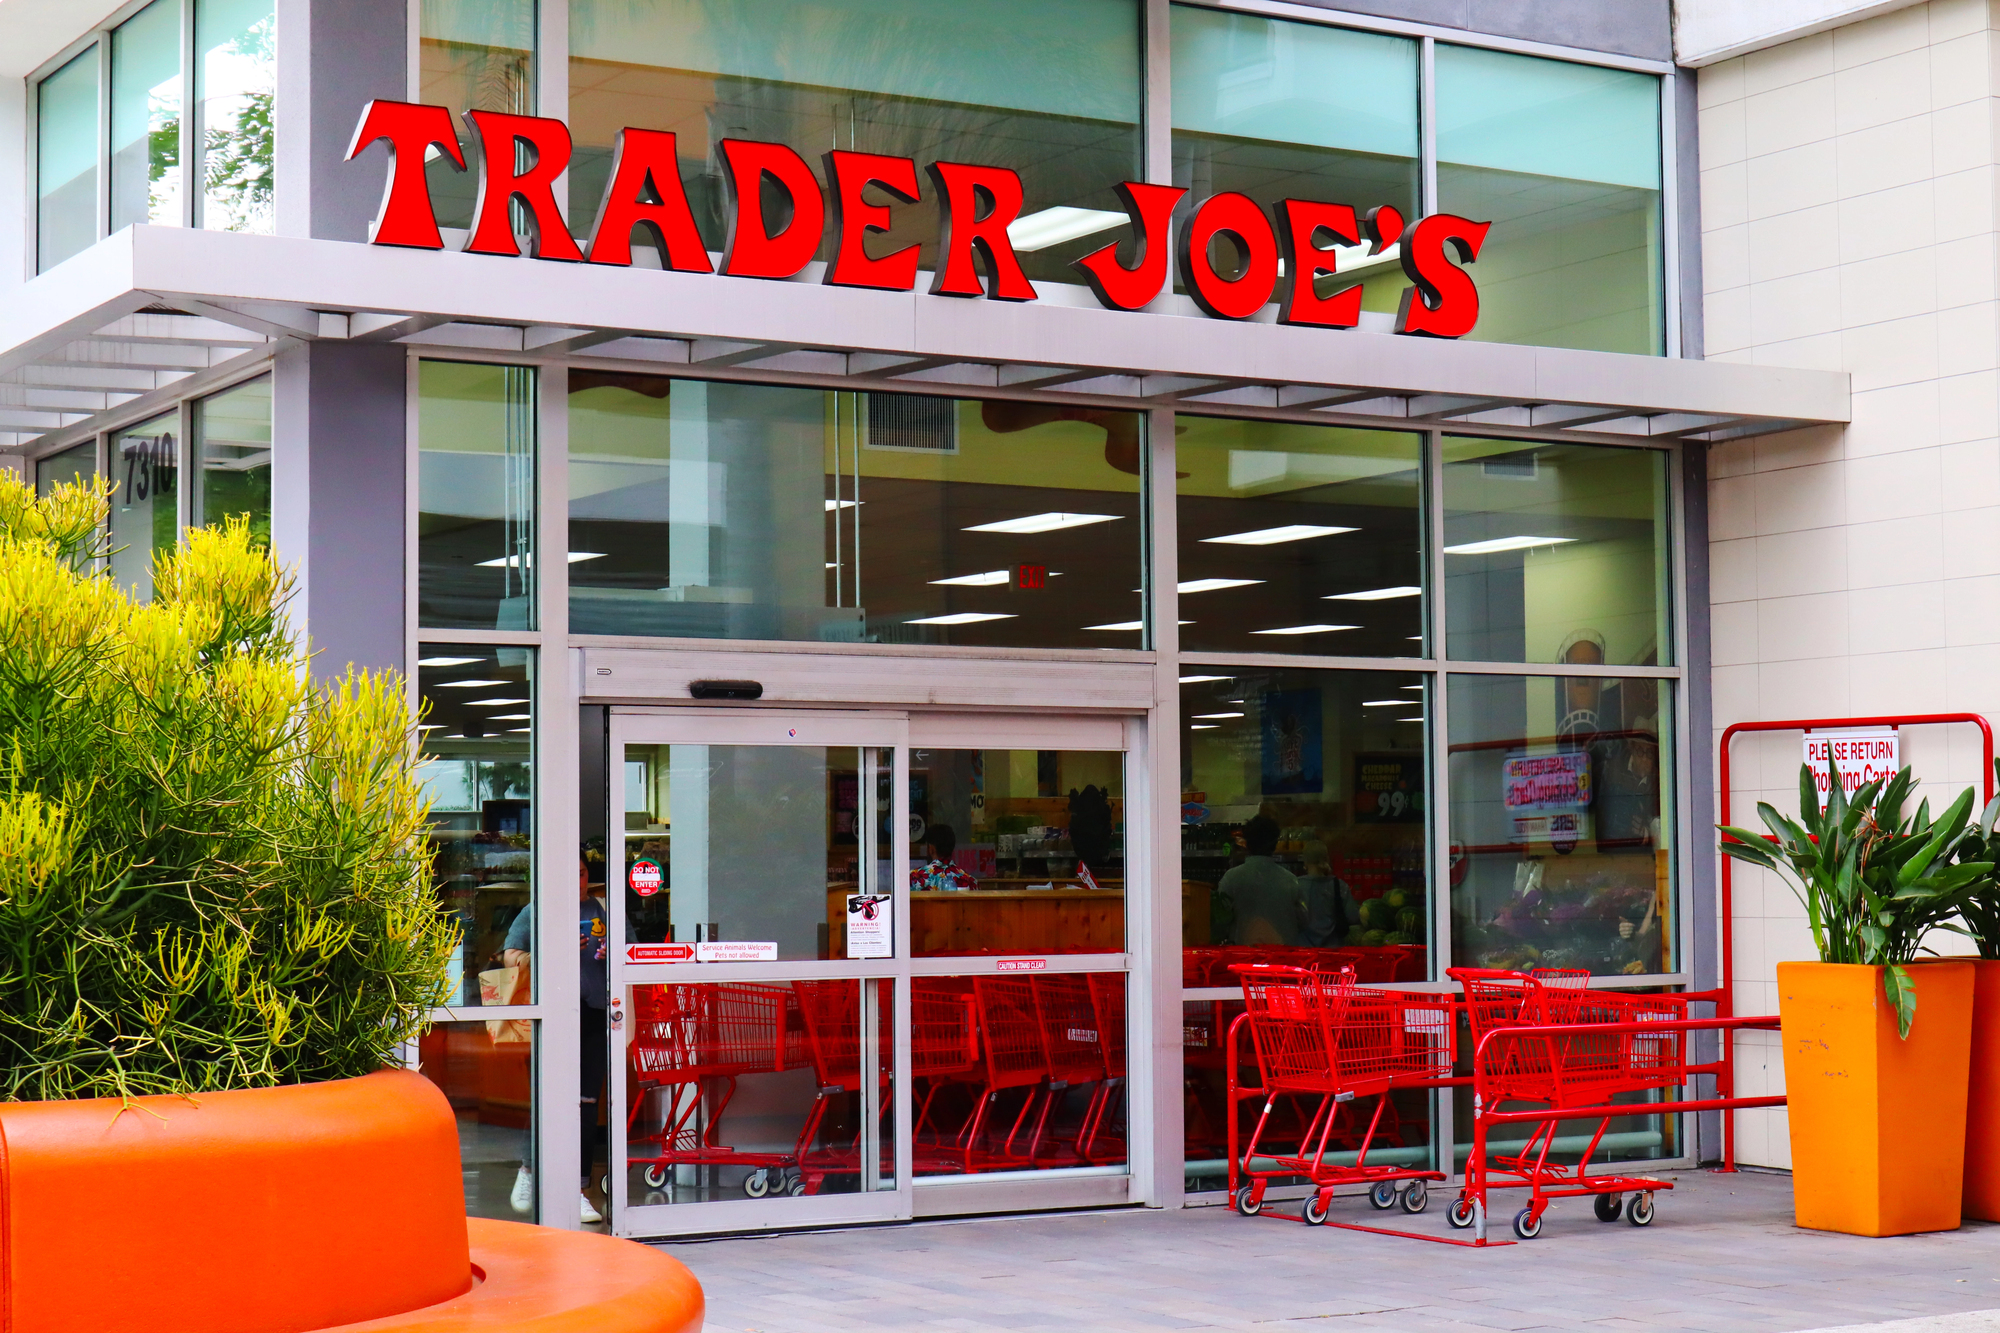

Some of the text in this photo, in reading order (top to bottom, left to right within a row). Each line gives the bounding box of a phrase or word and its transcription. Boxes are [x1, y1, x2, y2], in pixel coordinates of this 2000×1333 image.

[342, 98, 1492, 340] TRADER JOE'S
[124, 431, 173, 505] 7310
[1019, 565, 1046, 589] EXIT
[1809, 741, 1893, 761] PLESE RETURN
[998, 962, 1017, 970] CAUTION
[1030, 961, 1045, 969] CLEAR
